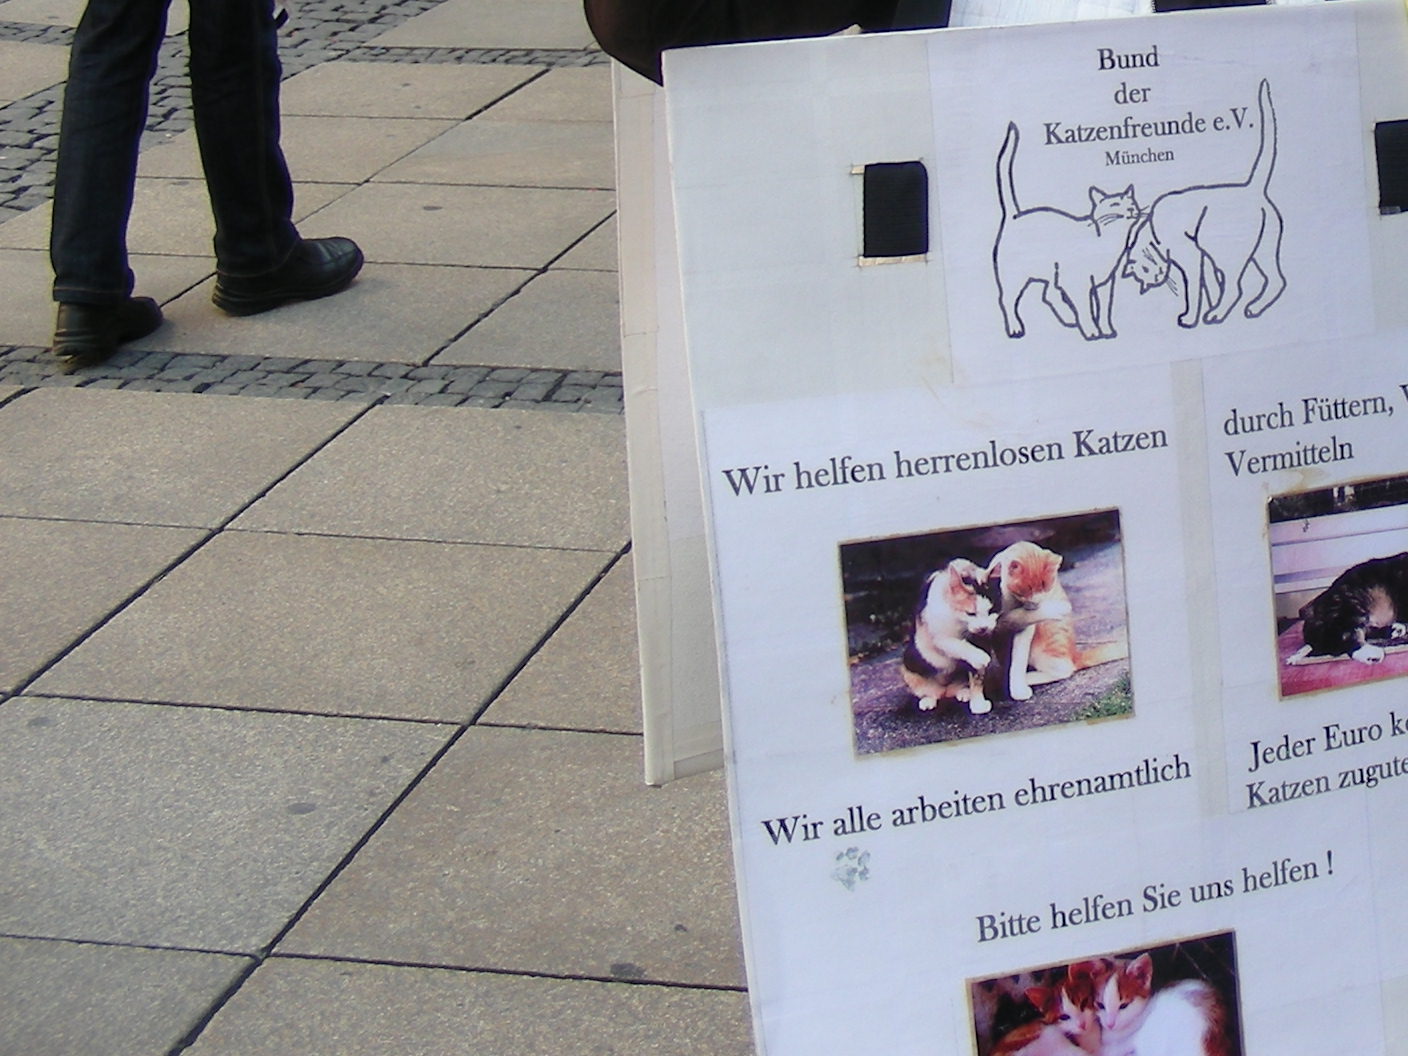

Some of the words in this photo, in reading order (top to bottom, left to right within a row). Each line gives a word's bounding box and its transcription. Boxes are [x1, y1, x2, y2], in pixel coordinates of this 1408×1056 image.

[1097, 45, 1160, 71] Bund
[1114, 82, 1151, 105] der
[1043, 112, 1206, 145] Katzenfreunde
[1212, 107, 1255, 132] e.V.
[1105, 147, 1174, 167] München
[1223, 402, 1295, 436] durch
[1302, 395, 1395, 426] Füttern,
[722, 465, 785, 497] Wir
[795, 455, 886, 491] helfen
[894, 441, 1064, 479] herrenlosen
[1072, 425, 1169, 459] Katzen
[1225, 436, 1354, 477] Vermitteln
[1248, 734, 1316, 773] Jeder
[1323, 723, 1383, 753] Euro
[761, 814, 824, 846] Wir
[832, 806, 883, 838] alle
[891, 790, 1007, 828] arbeiten
[1013, 754, 1192, 808] ehrenamtlich
[1245, 772, 1331, 810] Katzen
[976, 911, 1041, 943] Bitte
[1050, 893, 1134, 930] helfen
[1142, 883, 1182, 914] Sie
[1190, 877, 1235, 904] uns
[1241, 858, 1320, 894] helfen
[1326, 849, 1335, 876] !
